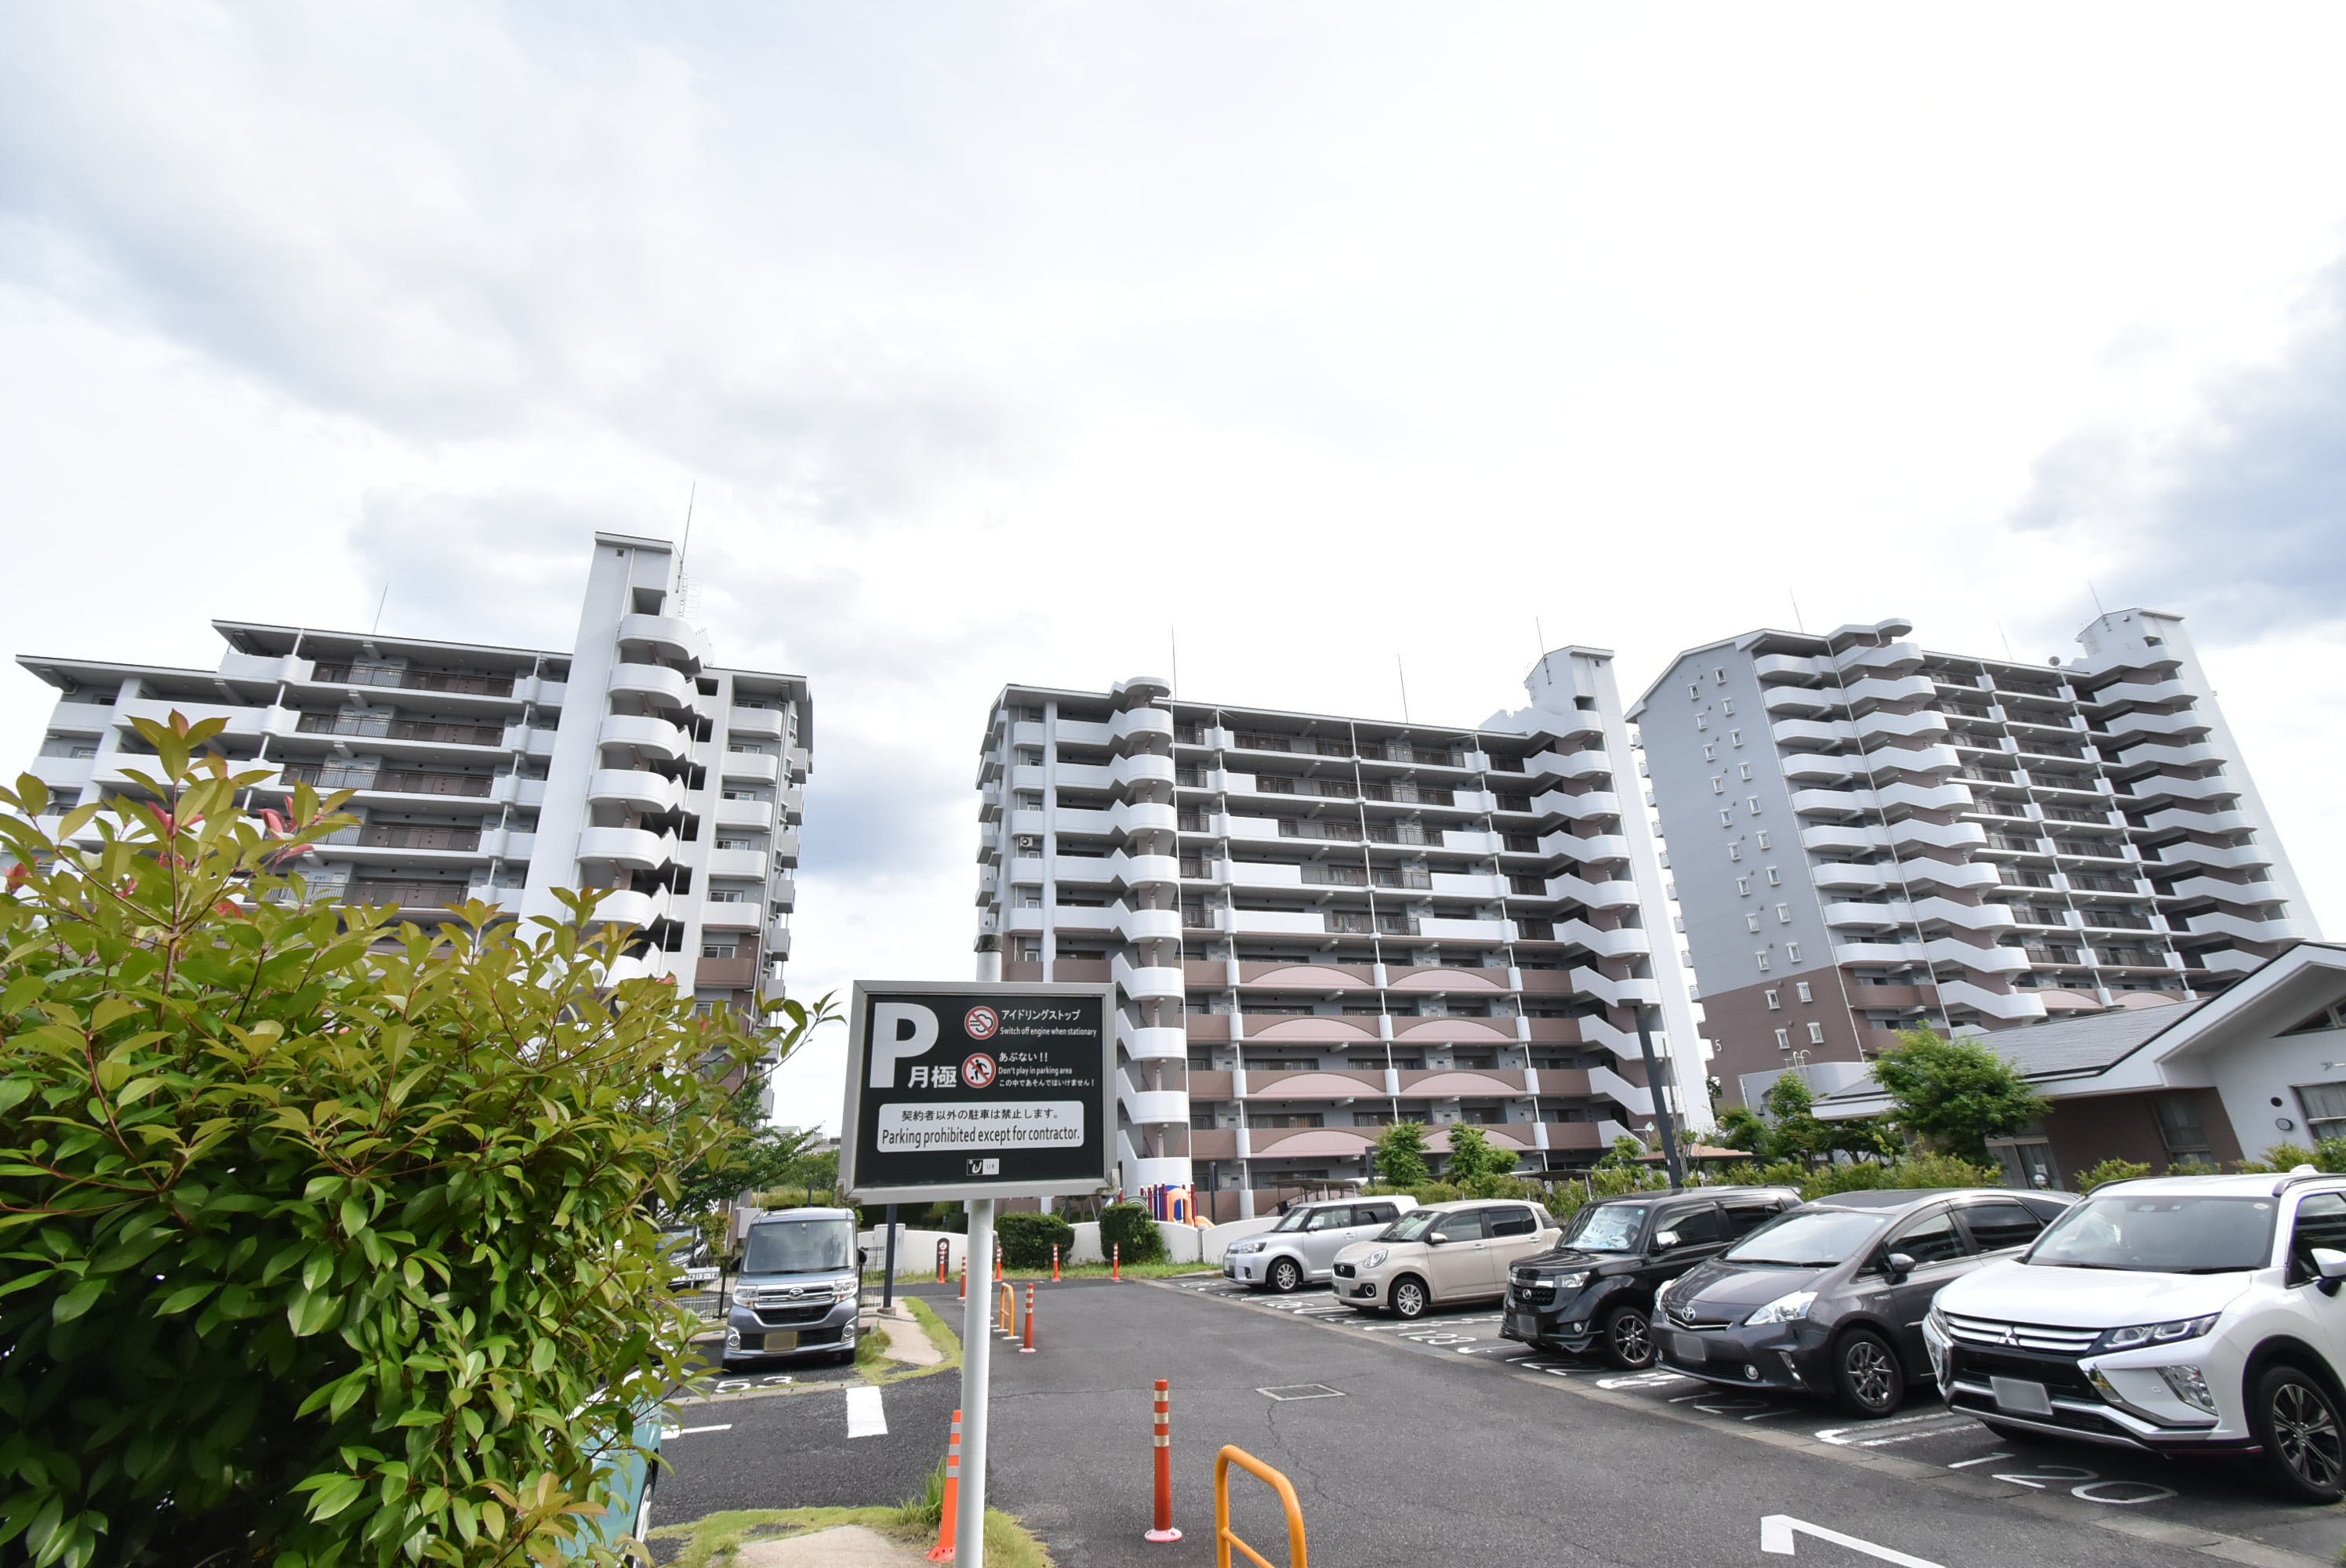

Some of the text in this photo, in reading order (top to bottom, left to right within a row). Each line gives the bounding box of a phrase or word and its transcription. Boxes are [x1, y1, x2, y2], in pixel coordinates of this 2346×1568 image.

[1001, 1009, 1080, 1021] アイドリングストップ
[1021, 1026, 1030, 1035] off
[1031, 1027, 1050, 1037] engine
[1067, 1027, 1097, 1037] stationary
[870, 1003, 939, 1088] P
[1715, 1039, 1722, 1051] 5
[908, 1065, 957, 1088] 月極
[1016, 1067, 1029, 1076] play
[1036, 1067, 1059, 1076] parking
[902, 1108, 1058, 1122] 契約者以外の駐車は禁止します。
[882, 1125, 1080, 1149] Parking prohibited except for contractor.
[1398, 1330, 1477, 1345] 123
[1948, 1453, 2178, 1504] 120
